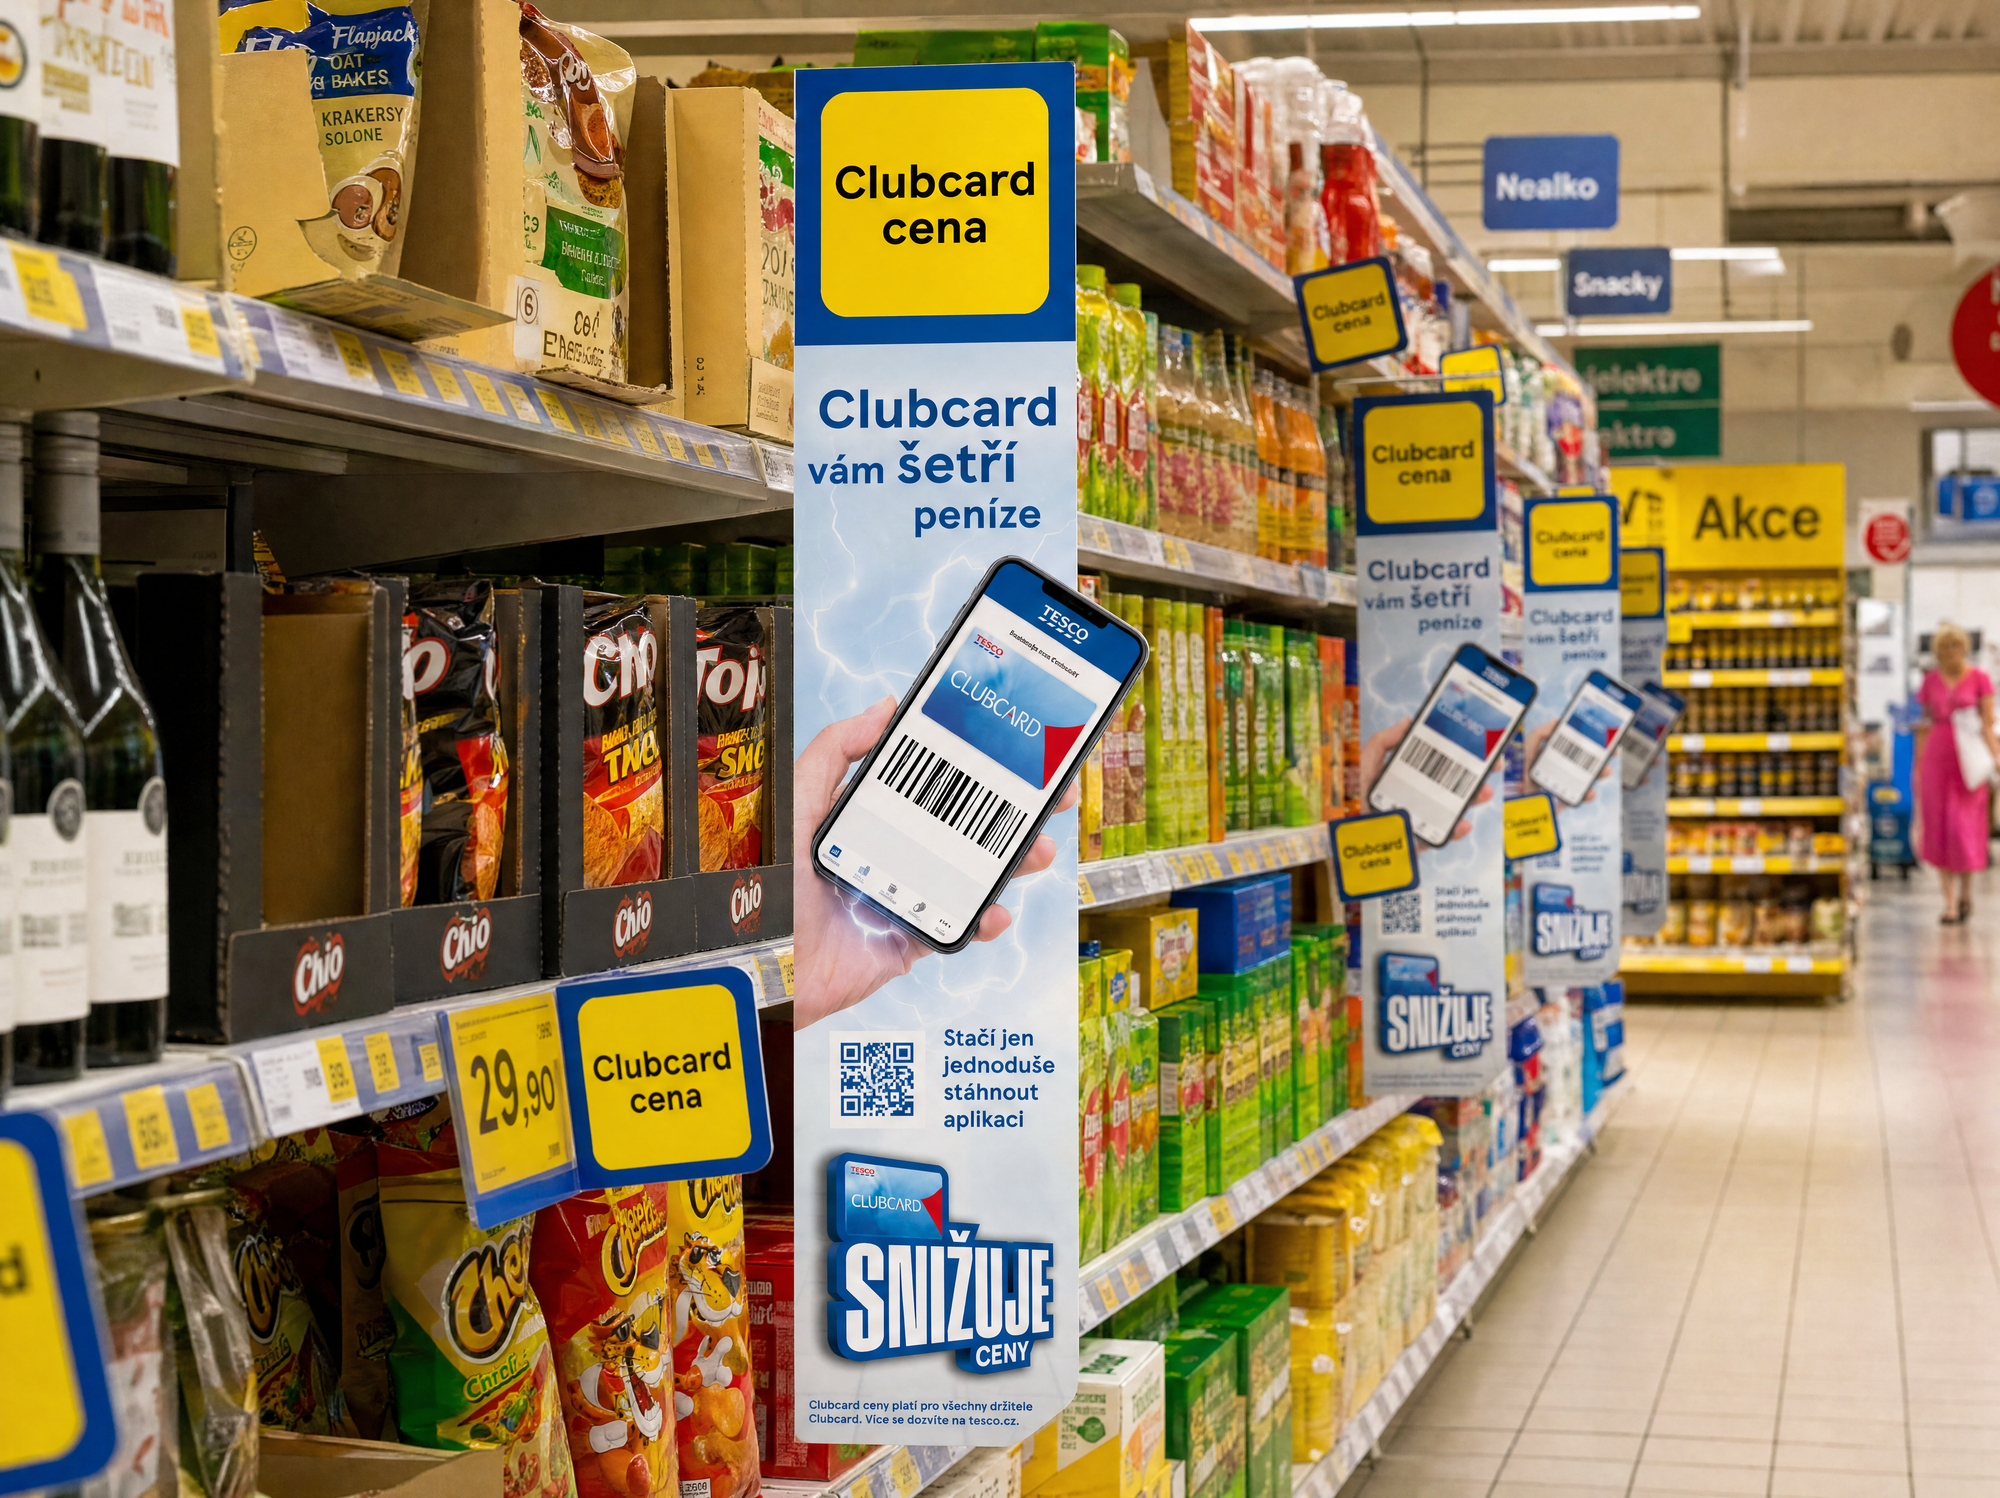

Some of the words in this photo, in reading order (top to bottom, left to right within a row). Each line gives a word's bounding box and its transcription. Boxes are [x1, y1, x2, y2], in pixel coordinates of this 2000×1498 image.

[332, 20, 416, 50] Flapjack
[330, 53, 365, 70] OAT
[331, 69, 389, 89] BAKES
[322, 106, 404, 127] KRAKERSY
[325, 127, 383, 146] SOLONE
[835, 161, 1035, 200] Clubcard
[1496, 171, 1599, 201] Nealko
[882, 217, 987, 245] cena
[1573, 270, 1663, 301] Snacky
[1312, 291, 1386, 321] Clubcard
[1333, 313, 1372, 334] cena
[819, 386, 1057, 429] Clubcard
[807, 454, 884, 485] vám
[897, 439, 1018, 484] šetří
[1371, 440, 1475, 465] Clubcard
[1397, 468, 1451, 485] cena
[915, 497, 1041, 538] peníze
[1694, 494, 1821, 541] Akce
[1535, 530, 1605, 545] Clubcard
[1367, 557, 1490, 582] Clubcard
[1363, 592, 1404, 611] vám
[1410, 584, 1472, 609] šetří
[1044, 604, 1089, 641] TESCO
[1418, 613, 1482, 636] peníze
[1529, 606, 1614, 626] Clubcard
[975, 634, 1004, 659] TESCO
[950, 669, 1042, 738] CLUBCARD
[1342, 837, 1404, 860] Clubcard
[1359, 856, 1391, 871] cena
[731, 880, 762, 924] Chio
[615, 897, 651, 948] Chio
[442, 914, 490, 970] Chio
[295, 940, 344, 1004] Chio
[1387, 986, 1490, 1052] SNIŽUJE
[943, 1028, 996, 1046] Stačí
[1000, 1029, 1034, 1050] jen
[593, 1042, 732, 1082] Clubcard
[942, 1055, 1056, 1078] jednoduše
[470, 1049, 556, 1136] 29,90
[630, 1087, 703, 1114] cena
[943, 1083, 1039, 1101] stáhnout
[943, 1110, 1024, 1132] aplikaci
[850, 1166, 875, 1176] TESCO
[851, 1193, 922, 1213] CLUBCARD
[845, 1229, 1050, 1353] SNIŽUJE
[975, 1341, 1030, 1368] CENY
[808, 1399, 860, 1411] Clubcard
[863, 1402, 890, 1413] ceny
[892, 1400, 918, 1413] platí
[920, 1403, 940, 1414] pro
[942, 1400, 988, 1414] všechny
[990, 1401, 1033, 1412] držitele
[808, 1414, 863, 1425] Clubcard.
[865, 1414, 890, 1425] Více
[892, 1415, 906, 1425] se
[907, 1414, 949, 1425] dozvíte
[952, 1416, 967, 1426] na
[968, 1415, 1020, 1427] tesco.cz.
